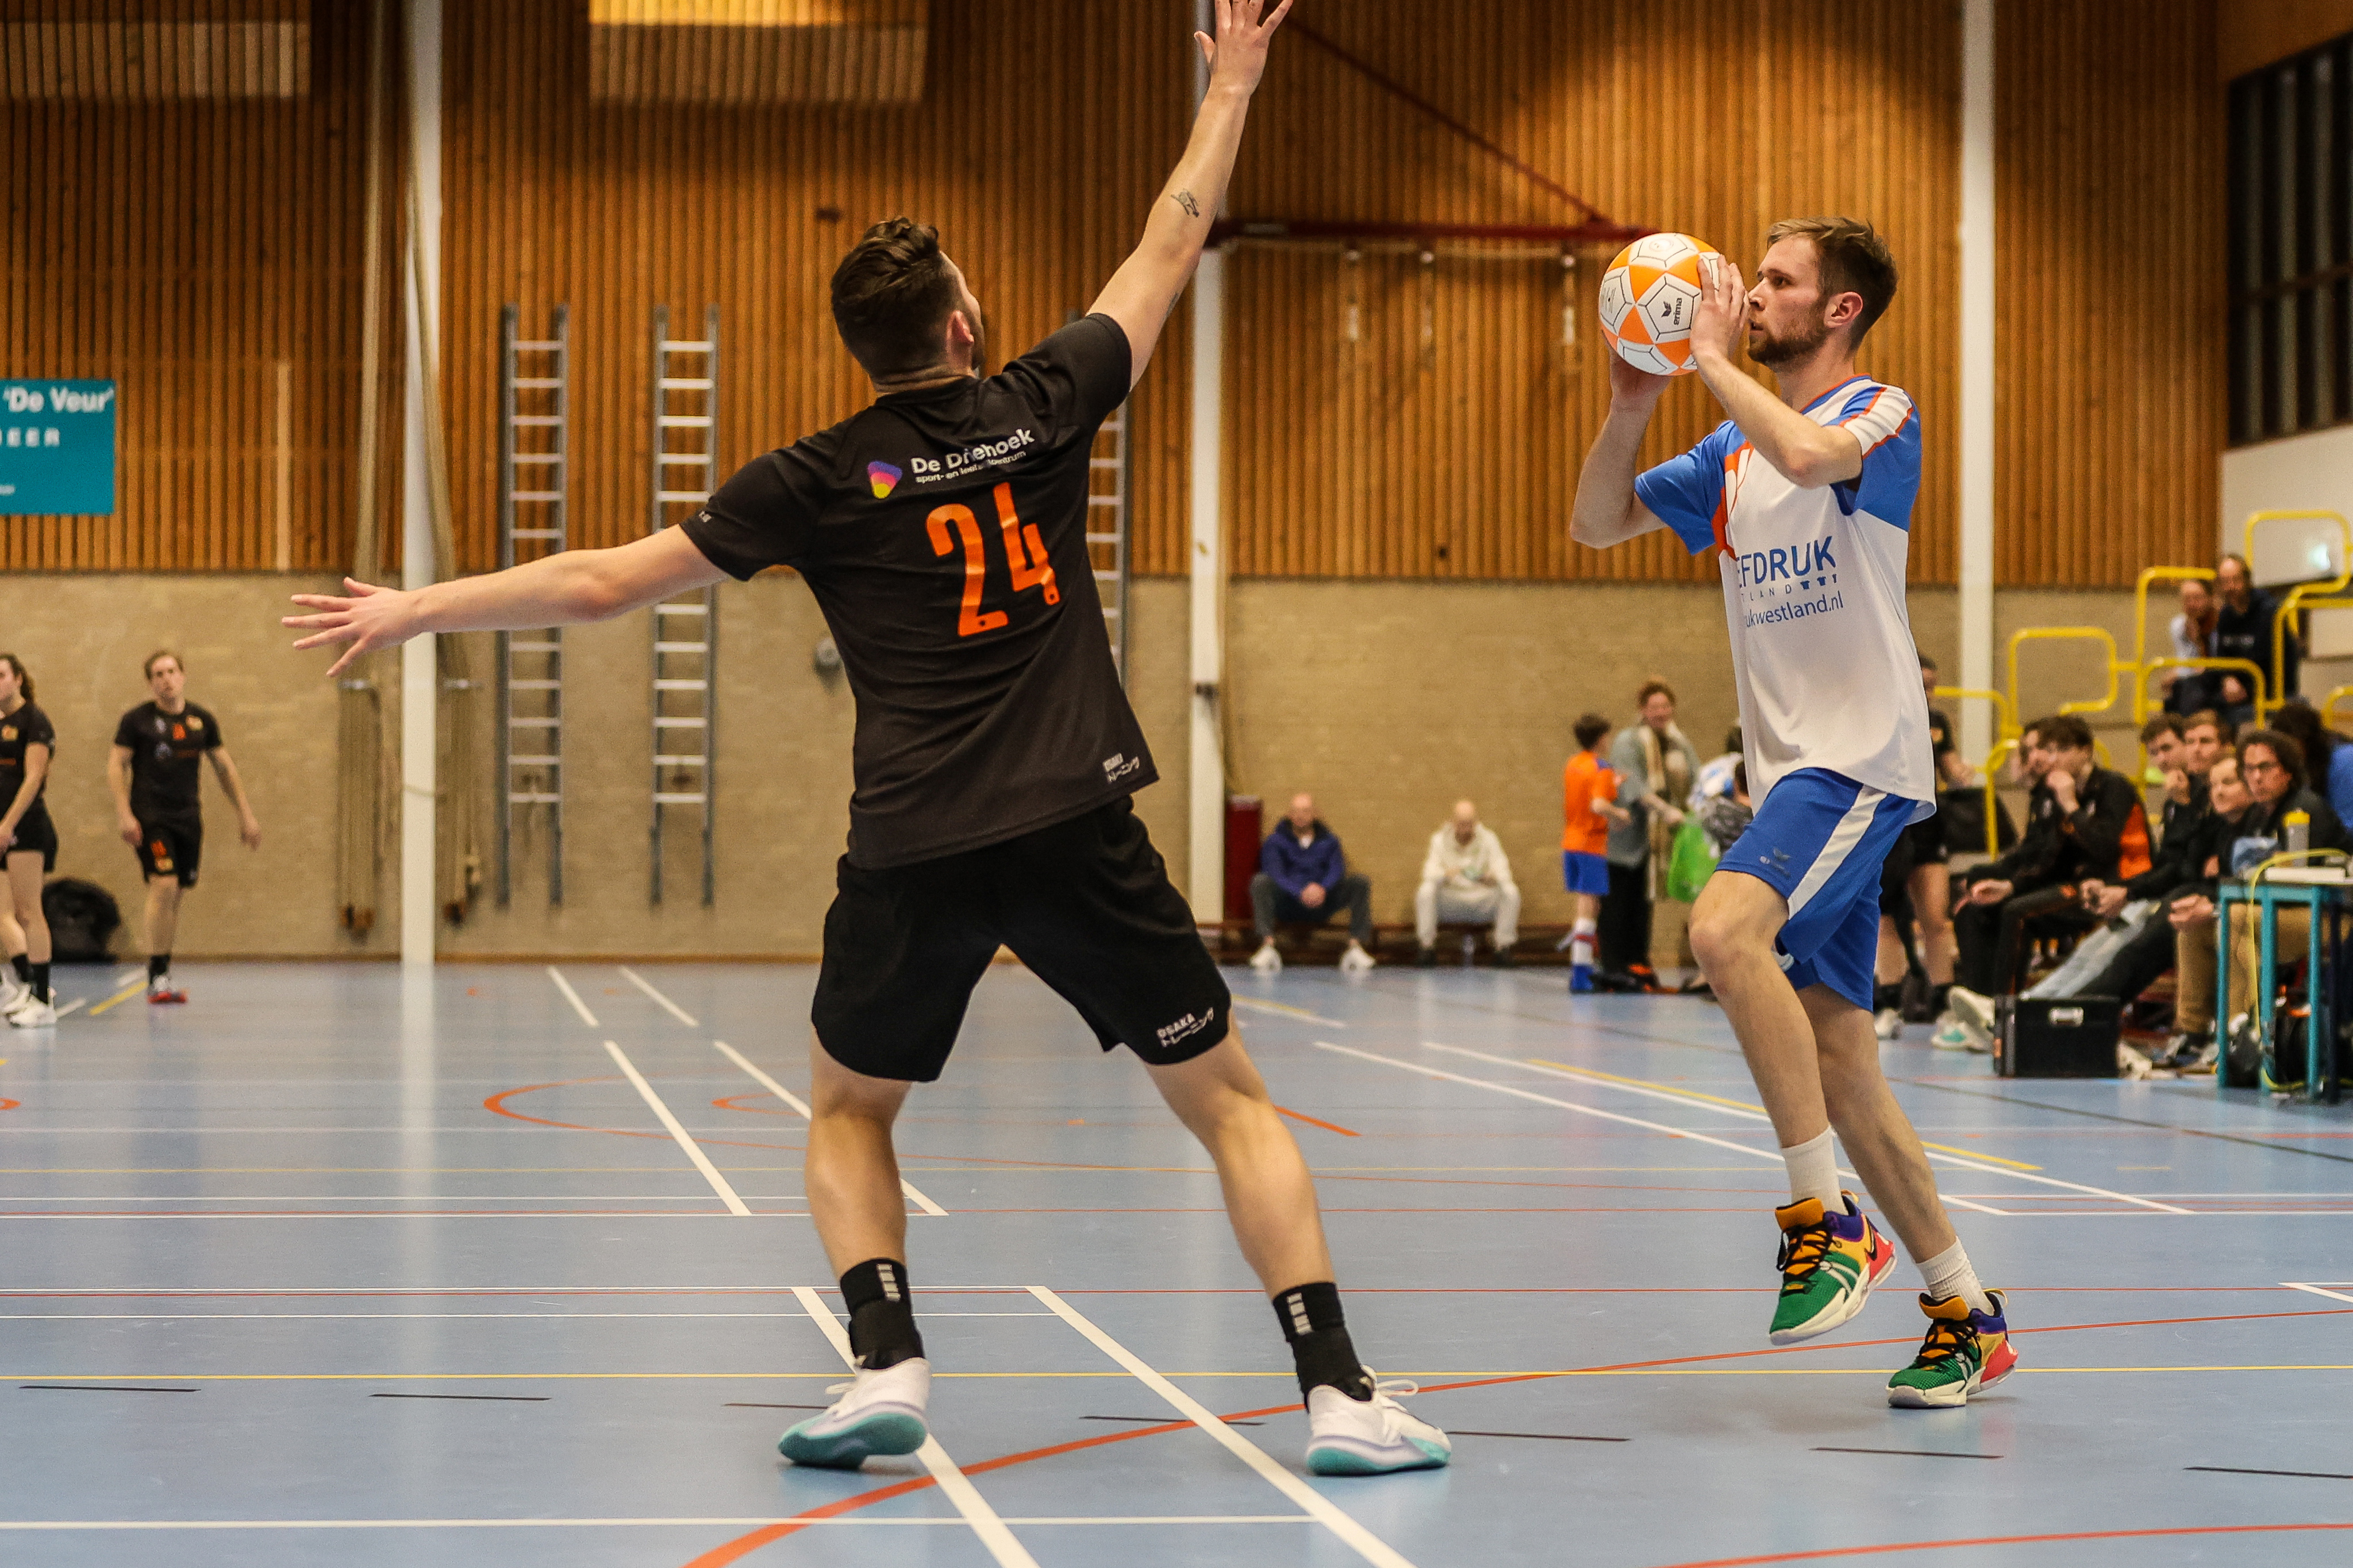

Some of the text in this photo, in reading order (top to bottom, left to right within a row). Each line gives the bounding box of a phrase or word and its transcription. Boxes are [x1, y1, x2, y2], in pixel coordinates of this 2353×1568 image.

[1673, 297, 1683, 326] erima
[910, 429, 1035, 474] De Driehoek
[916, 473, 944, 484] sport-
[945, 470, 959, 479] en
[925, 481, 1060, 637] 24
[1736, 536, 1836, 588] FDRUK
[1156, 1013, 1195, 1039] OSAKA
